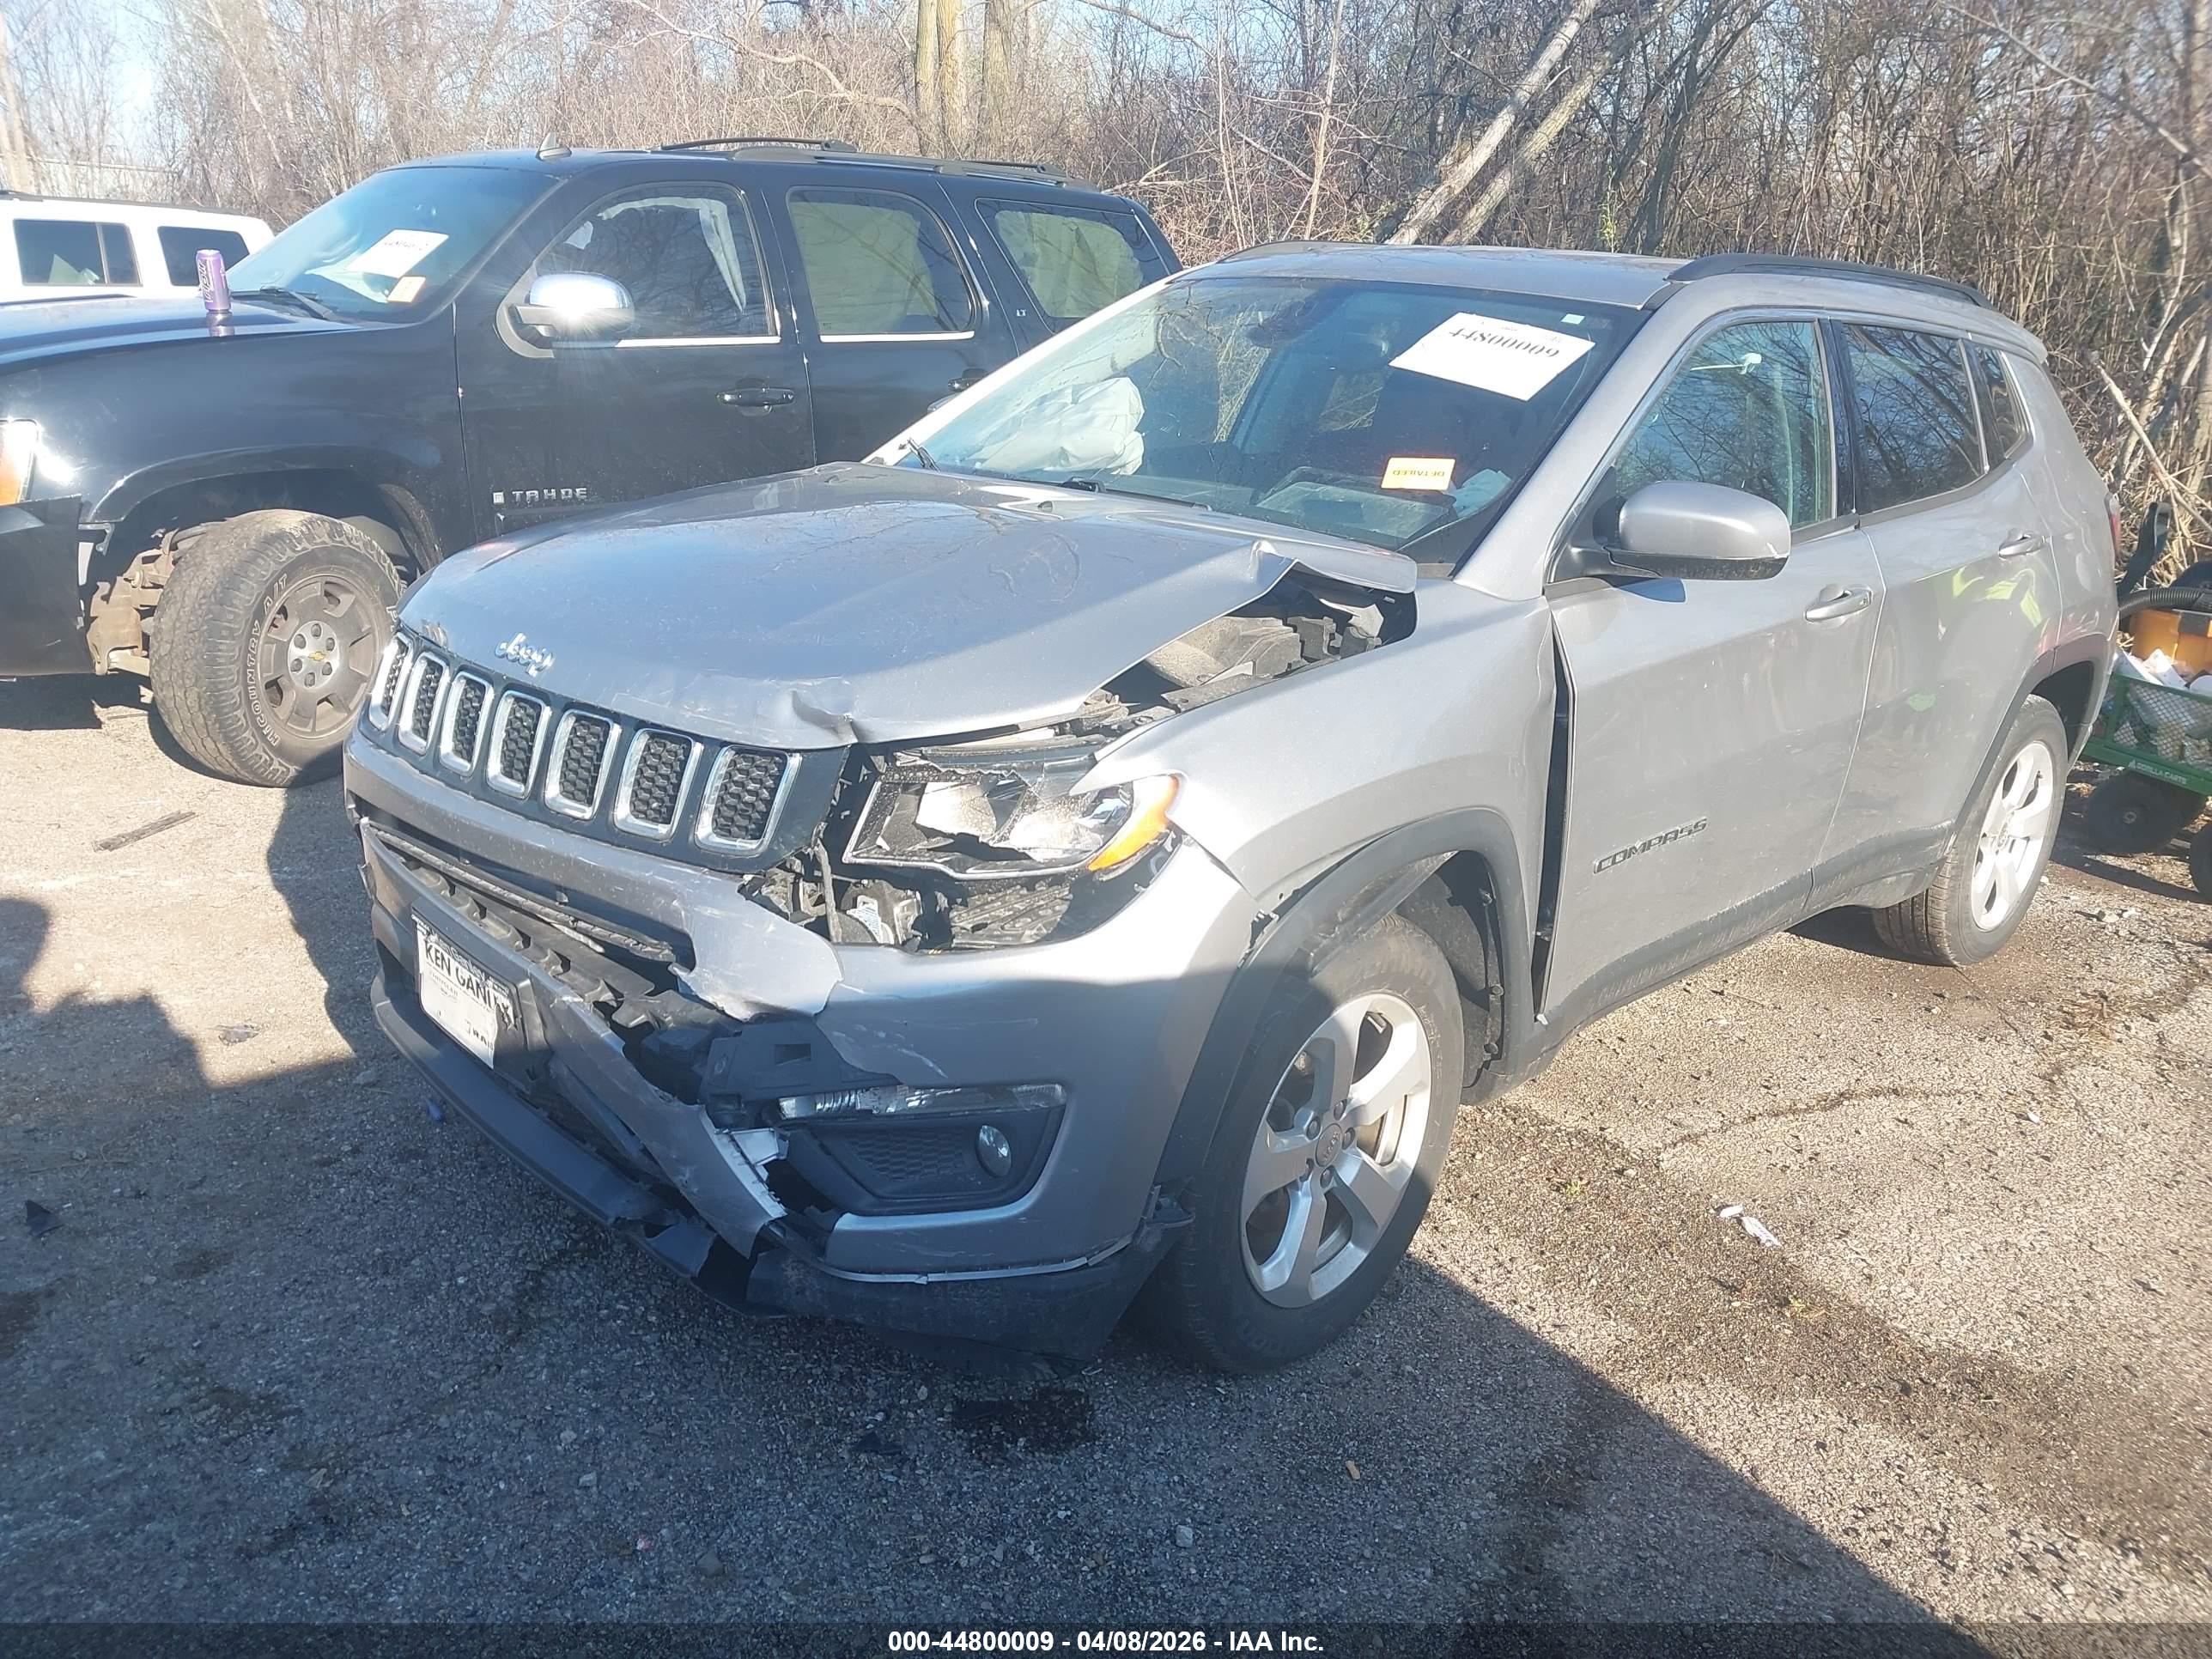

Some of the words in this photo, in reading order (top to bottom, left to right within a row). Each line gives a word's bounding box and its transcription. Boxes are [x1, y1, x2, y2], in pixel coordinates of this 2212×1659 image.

[1449, 327, 1560, 358] 44800009
[1392, 469, 1446, 477] DETAILED
[511, 487, 587, 502] TAHOE
[495, 632, 556, 678] Jeep
[1593, 816, 1708, 874] COMPASS
[424, 940, 452, 977] KEN
